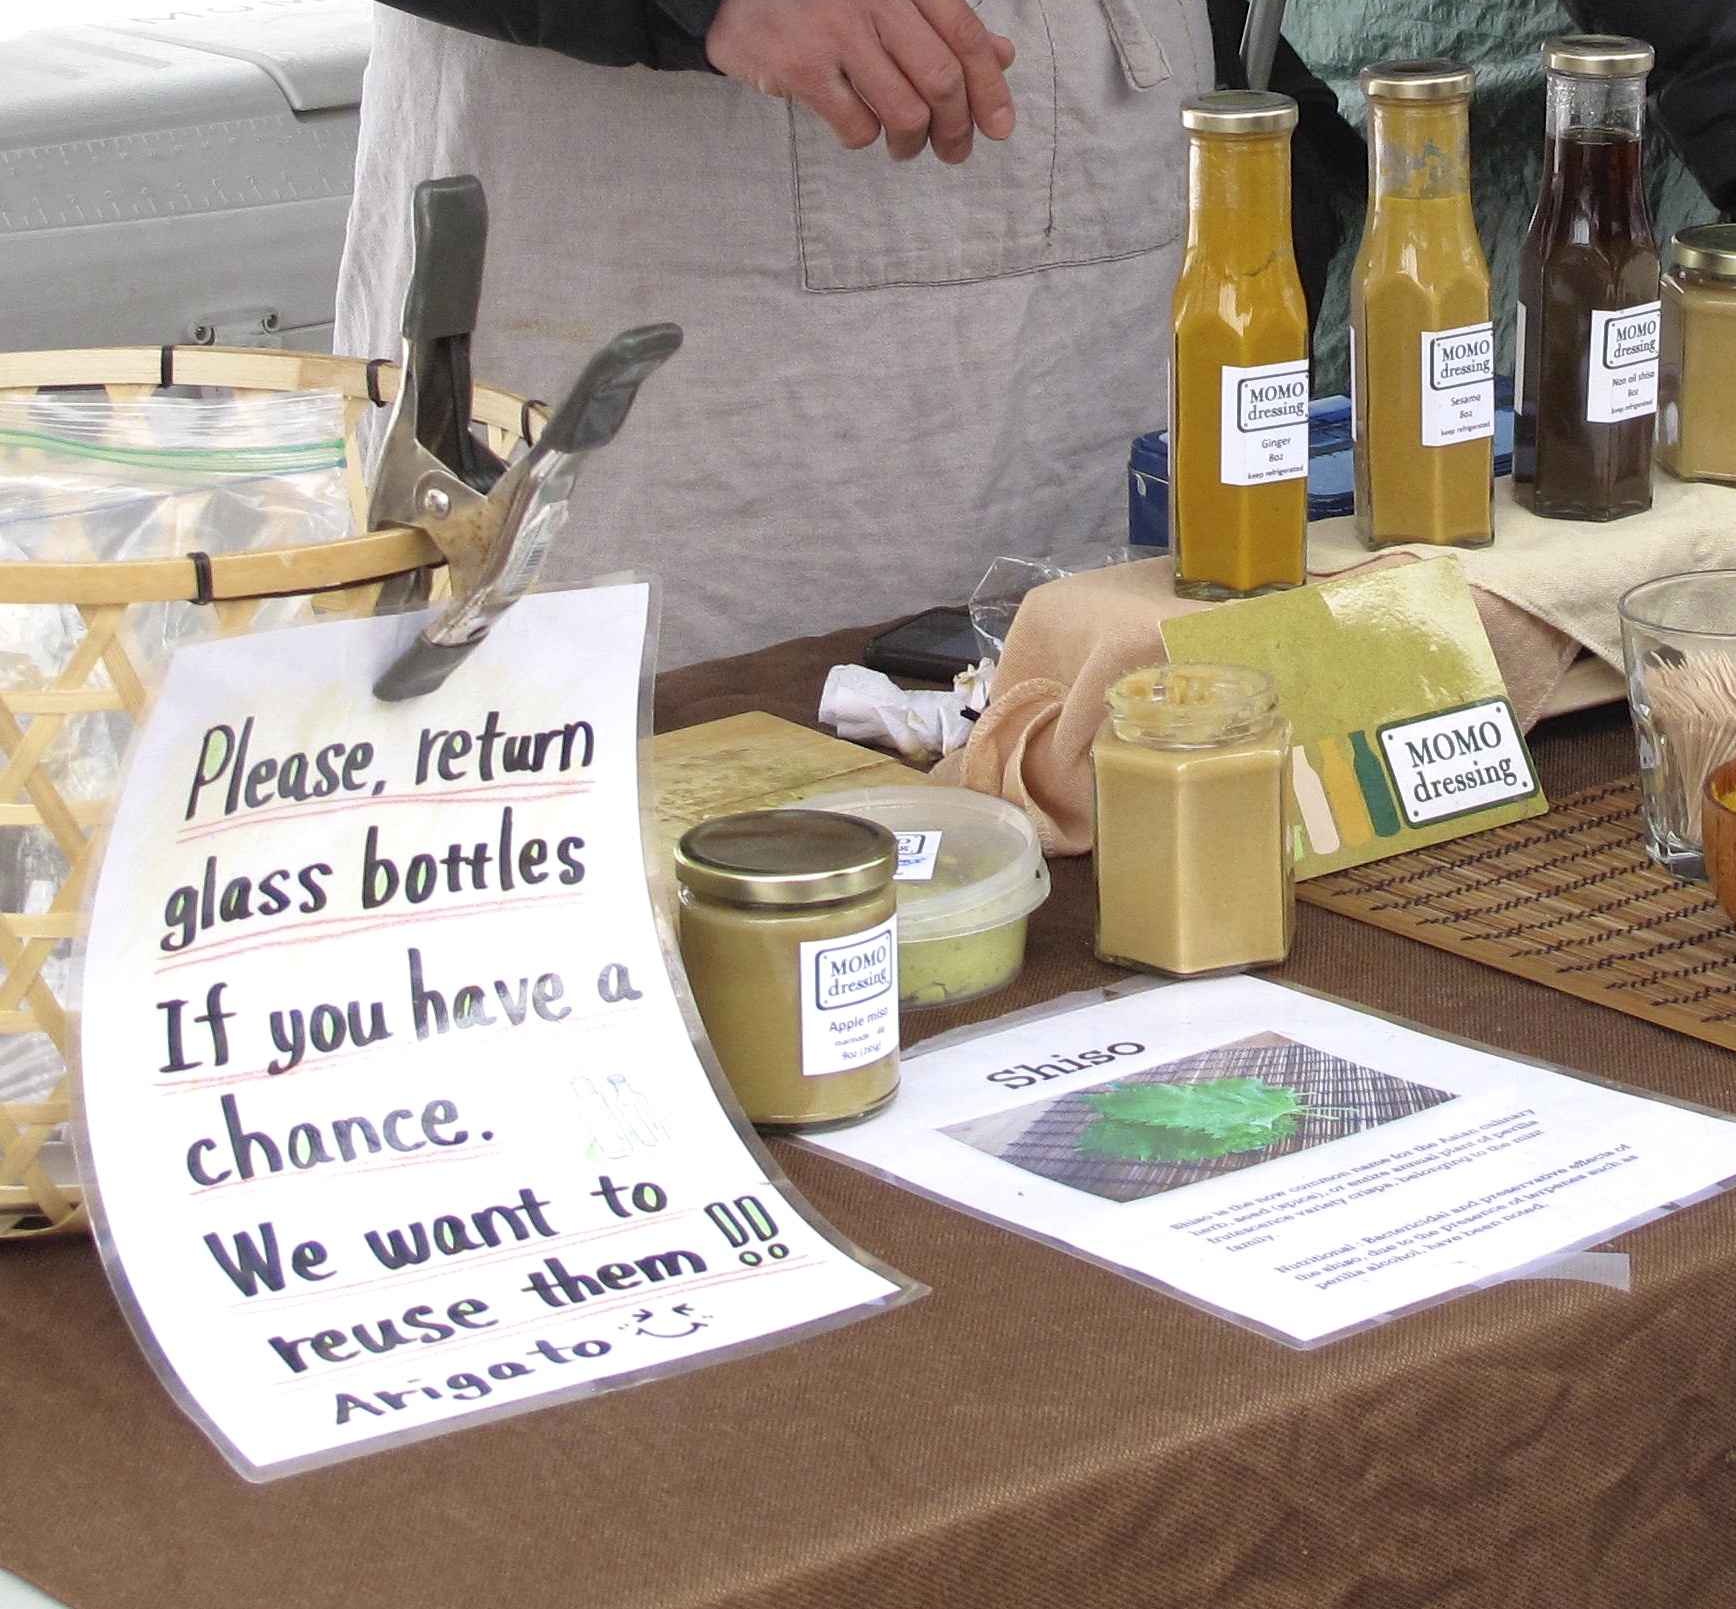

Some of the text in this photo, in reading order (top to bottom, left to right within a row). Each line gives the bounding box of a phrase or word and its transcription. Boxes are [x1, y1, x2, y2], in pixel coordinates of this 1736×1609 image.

[1615, 320, 1657, 342] MOMO
[1441, 340, 1491, 363] MOMO
[1613, 339, 1656, 358] dressing
[1440, 358, 1491, 379] dressing
[1250, 382, 1305, 404] MOMO
[1450, 393, 1481, 407] Sesame
[1247, 402, 1304, 421] dressing
[1261, 437, 1291, 450] Ginger
[1247, 464, 1304, 480] keep refrigerated
[415, 711, 596, 786] return
[1405, 720, 1501, 768] MOMO
[1414, 758, 1518, 803] dressing
[160, 808, 586, 952] glass bottles
[830, 946, 886, 977] MOMO
[828, 967, 887, 997] dressing
[156, 948, 642, 1075] If you have a
[829, 1006, 888, 1034] Apple miso
[986, 1037, 1146, 1092] Shiso
[186, 1094, 494, 1186] chance.
[202, 1175, 669, 1301] We want to
[270, 1296, 500, 1372] reuse
[522, 1244, 708, 1310] them
[335, 1335, 612, 1424] Arigato
